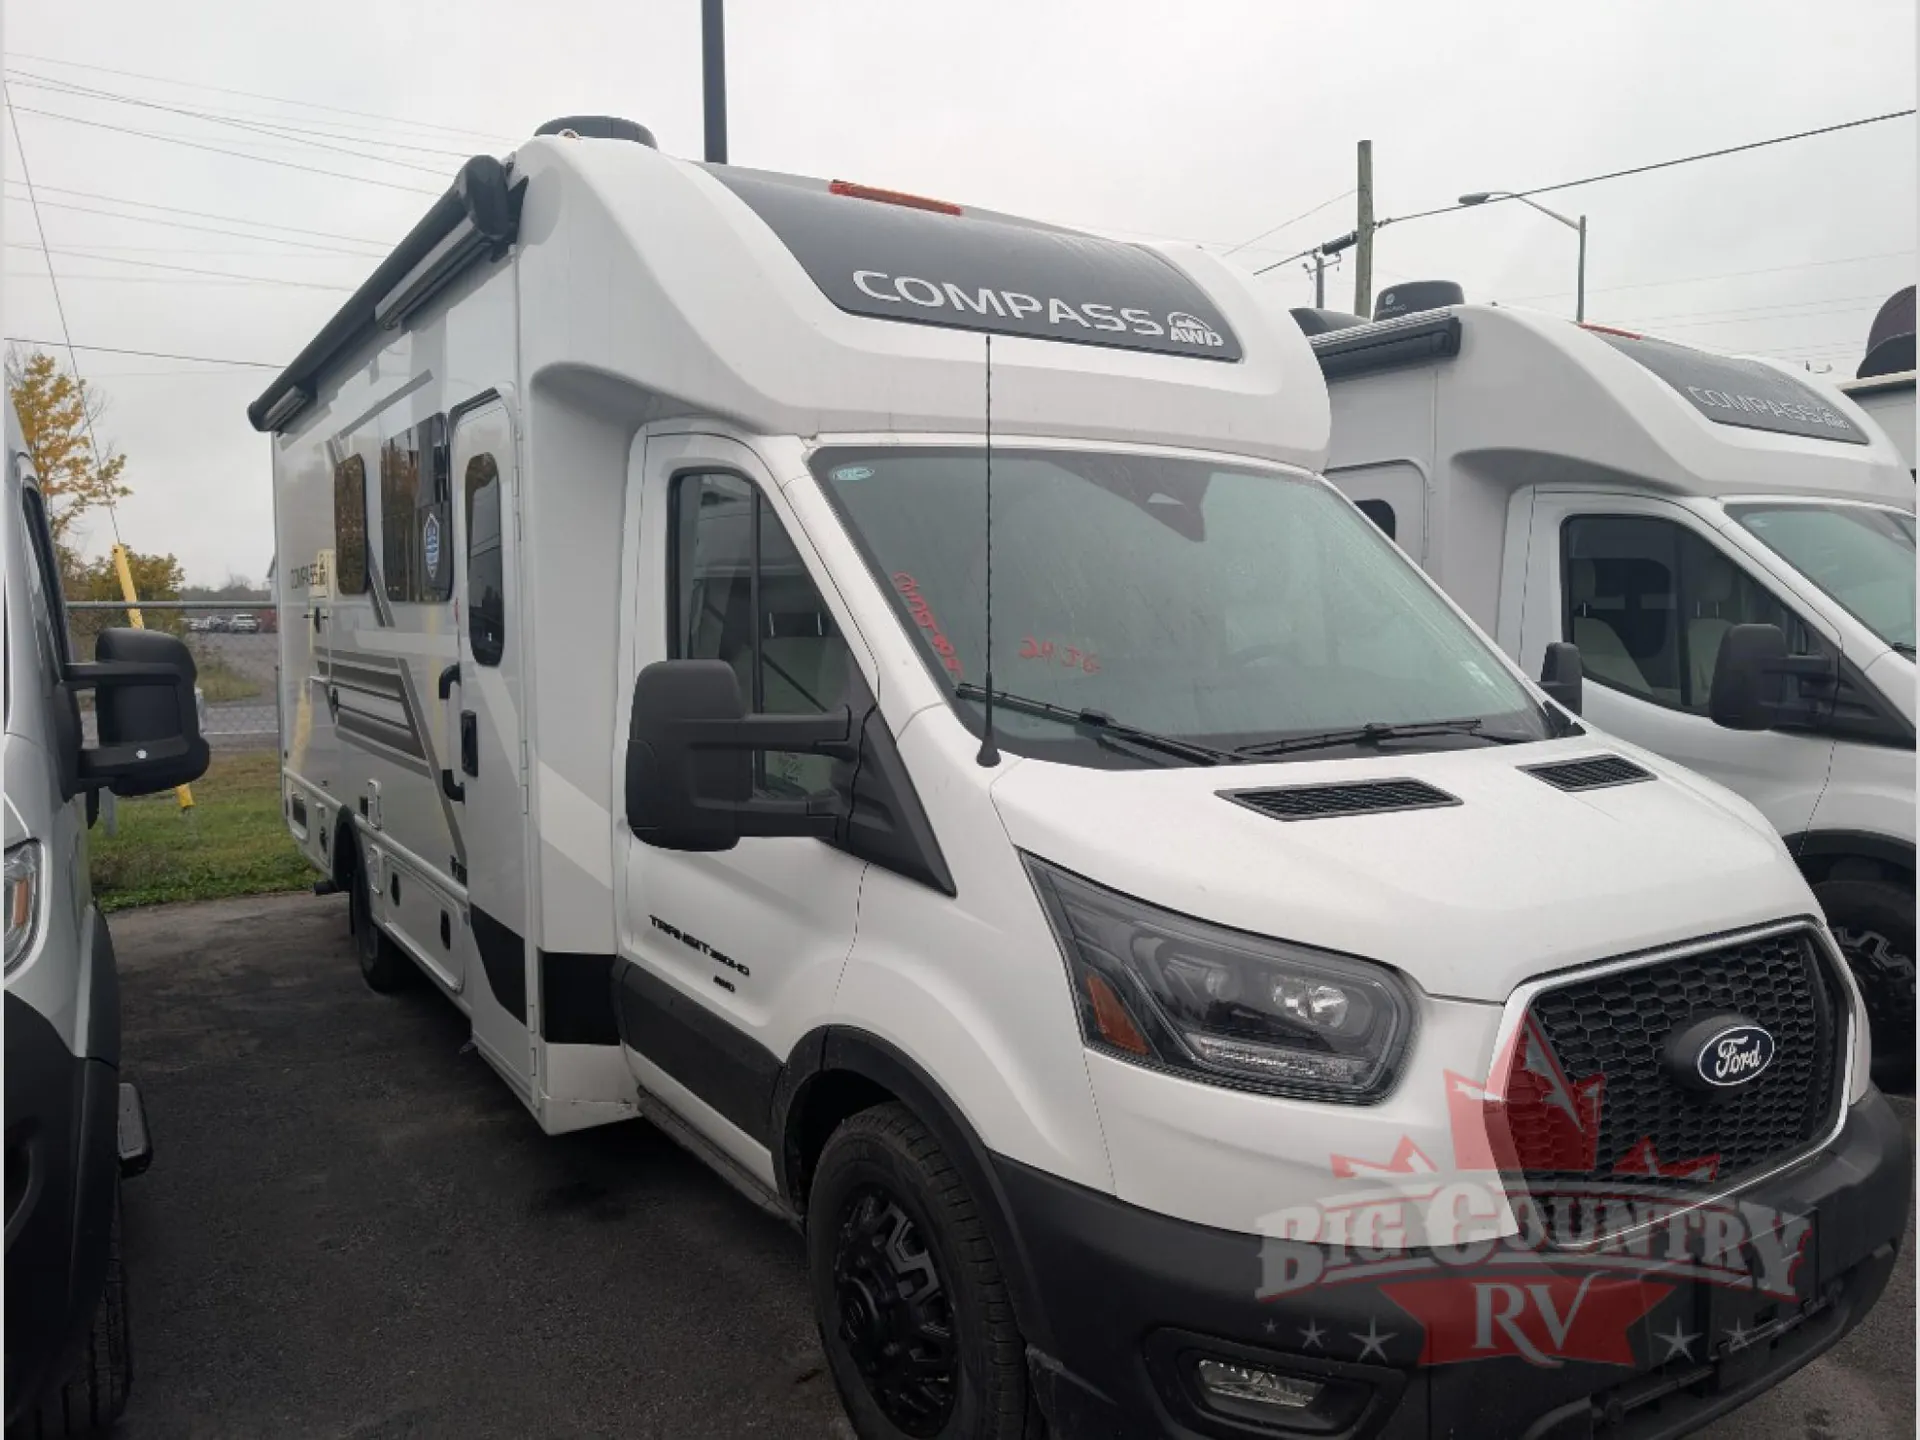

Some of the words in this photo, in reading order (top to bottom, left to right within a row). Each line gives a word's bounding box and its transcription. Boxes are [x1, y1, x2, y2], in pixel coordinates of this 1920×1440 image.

[852, 270, 1164, 336] COMPASS
[1171, 326, 1224, 346] AWD
[1715, 1035, 1761, 1078] Ford
